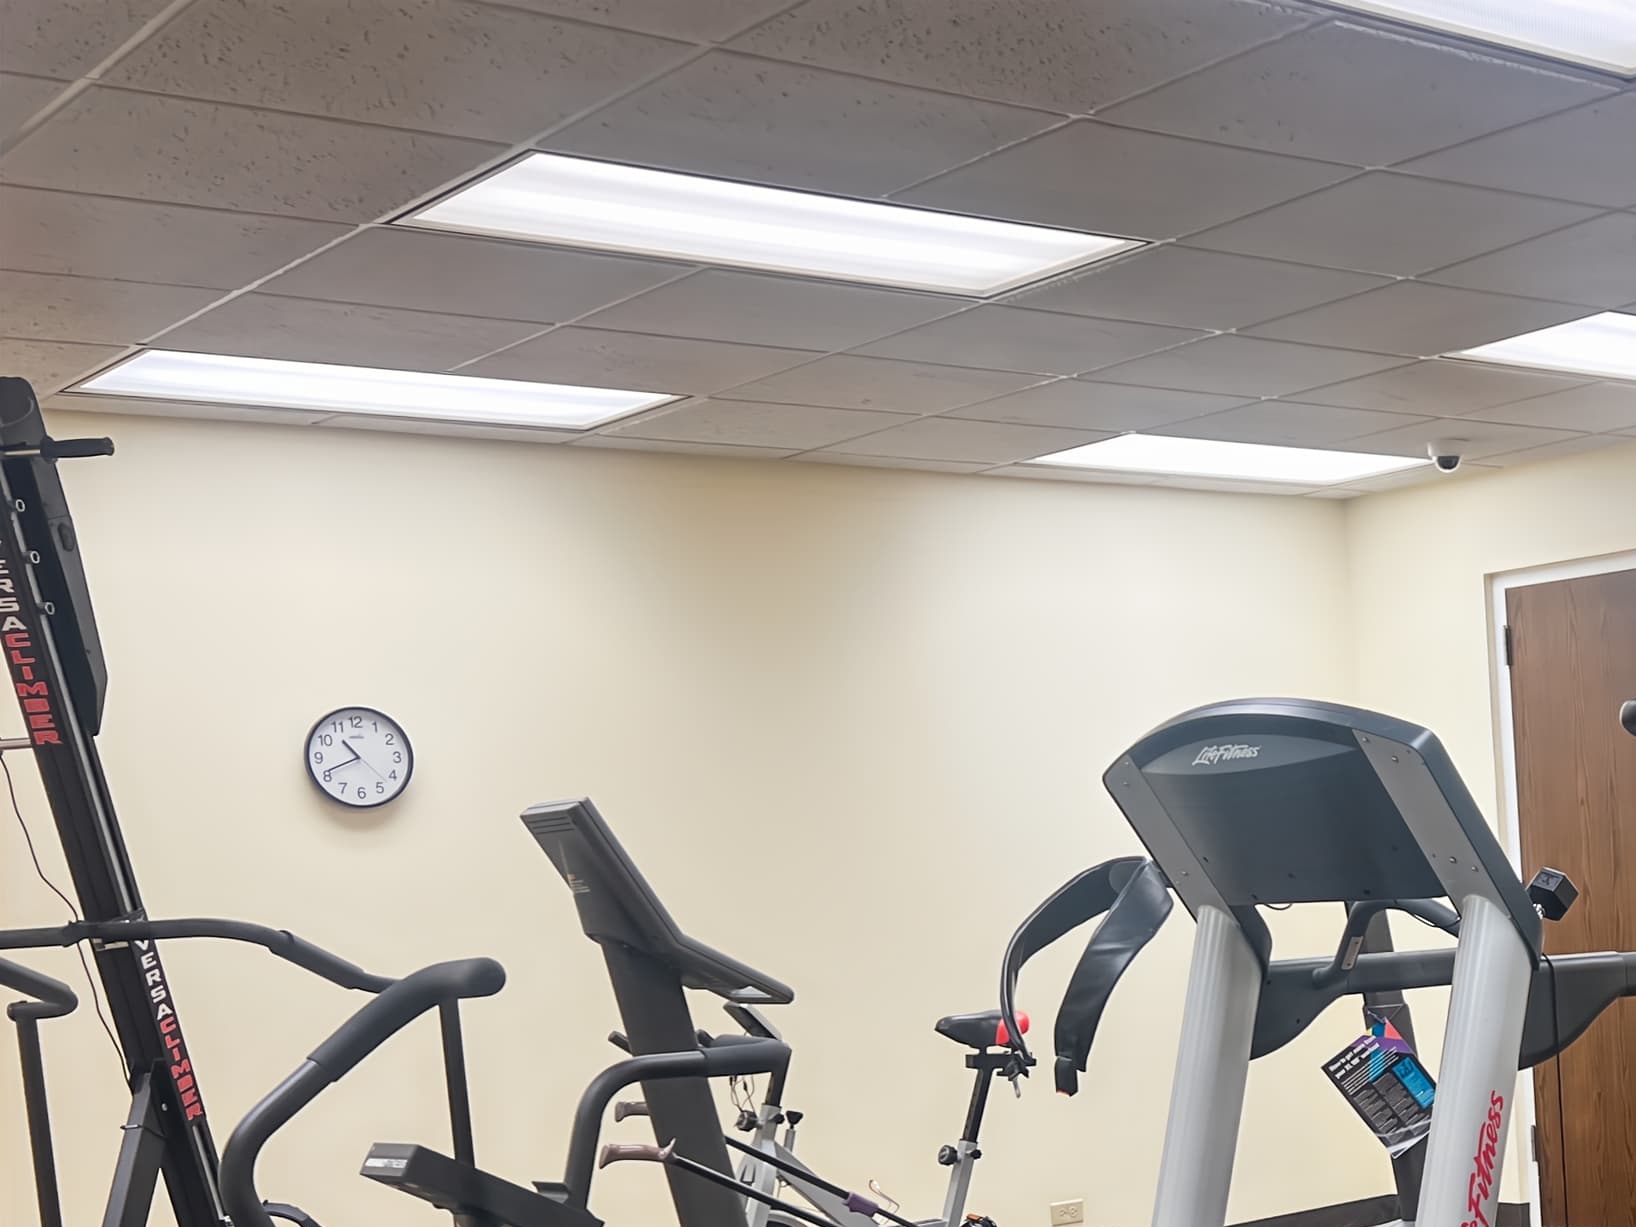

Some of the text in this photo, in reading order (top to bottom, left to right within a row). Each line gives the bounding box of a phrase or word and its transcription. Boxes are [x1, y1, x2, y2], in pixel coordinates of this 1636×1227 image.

[0, 539, 63, 745] RSACLIMBER
[331, 721, 344, 733] 11
[349, 716, 363, 728] 12
[372, 721, 378, 732] 1
[318, 734, 333, 746] 10
[385, 733, 394, 746] 2
[314, 751, 323, 764] 9
[393, 751, 402, 764] 3
[323, 770, 332, 782] 8
[388, 769, 398, 781] 4
[339, 782, 348, 794] 7
[357, 786, 367, 799] 6
[376, 782, 385, 794] 5
[133, 939, 204, 1121] VERSACLIMBER
